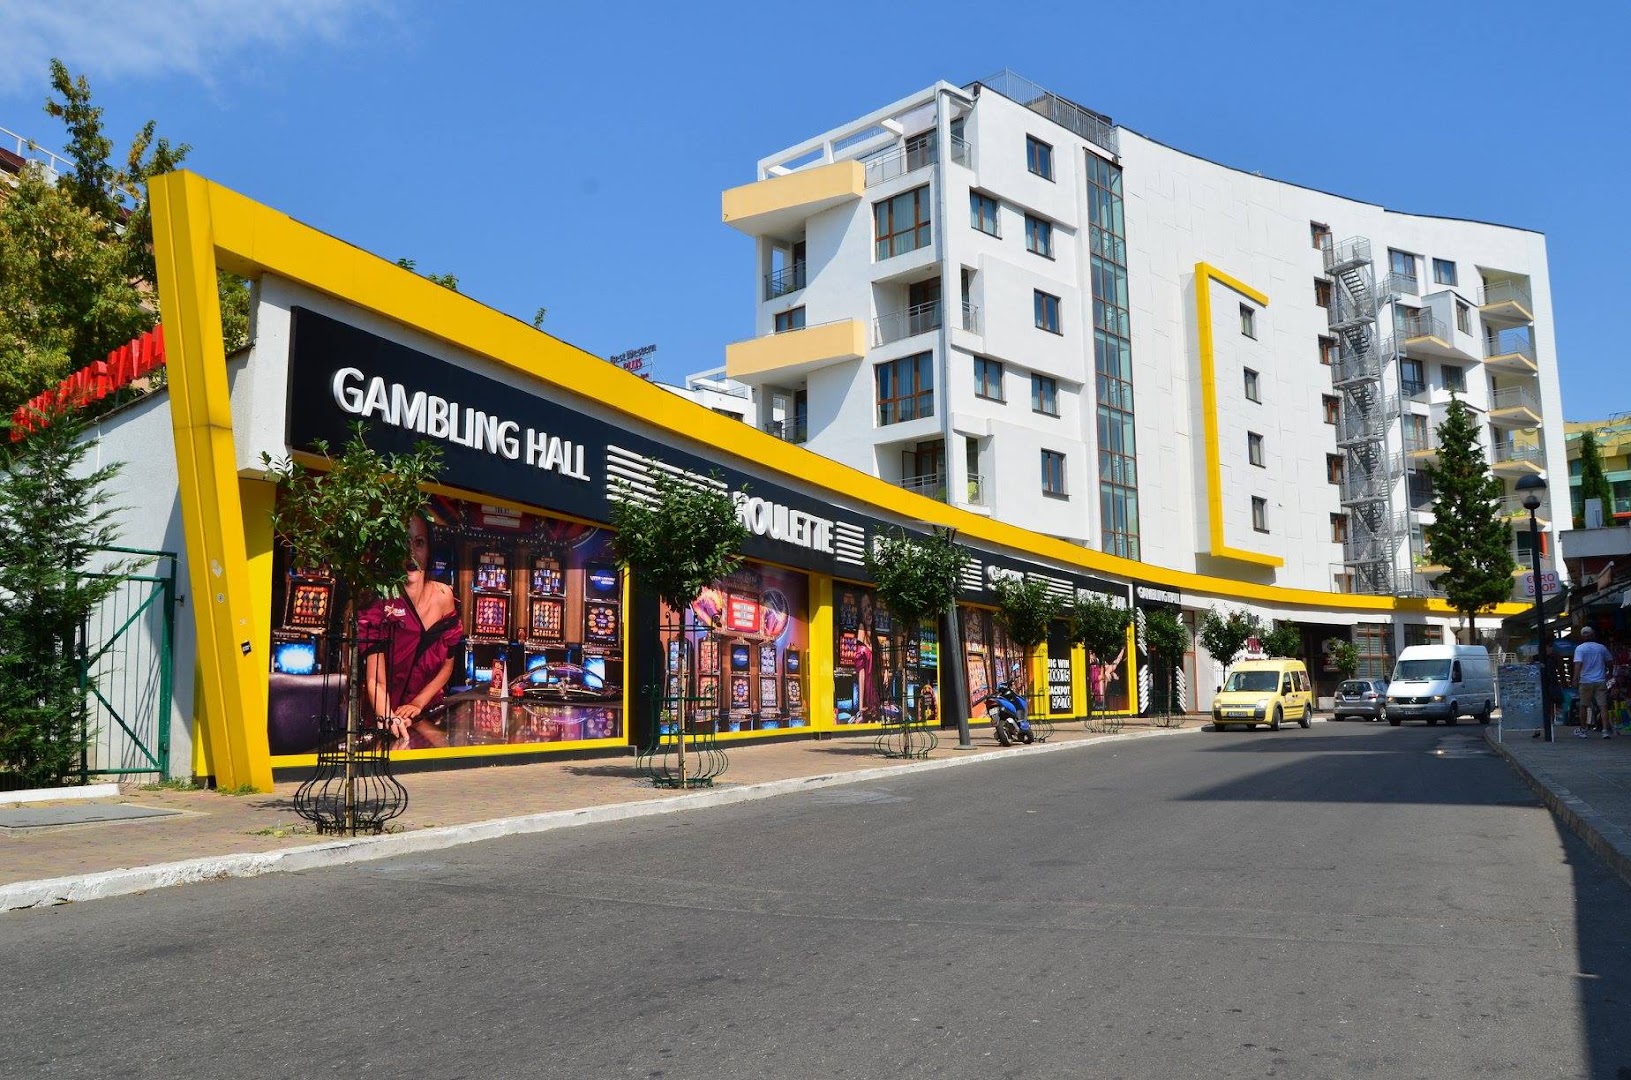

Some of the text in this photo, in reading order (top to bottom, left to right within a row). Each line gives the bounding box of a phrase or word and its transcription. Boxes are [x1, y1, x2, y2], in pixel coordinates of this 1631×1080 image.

[623, 357, 643, 370] PLUS
[332, 367, 591, 482] GAMBLING HALL
[732, 490, 834, 554] ROULETTE
[1528, 583, 1556, 594] SOP
